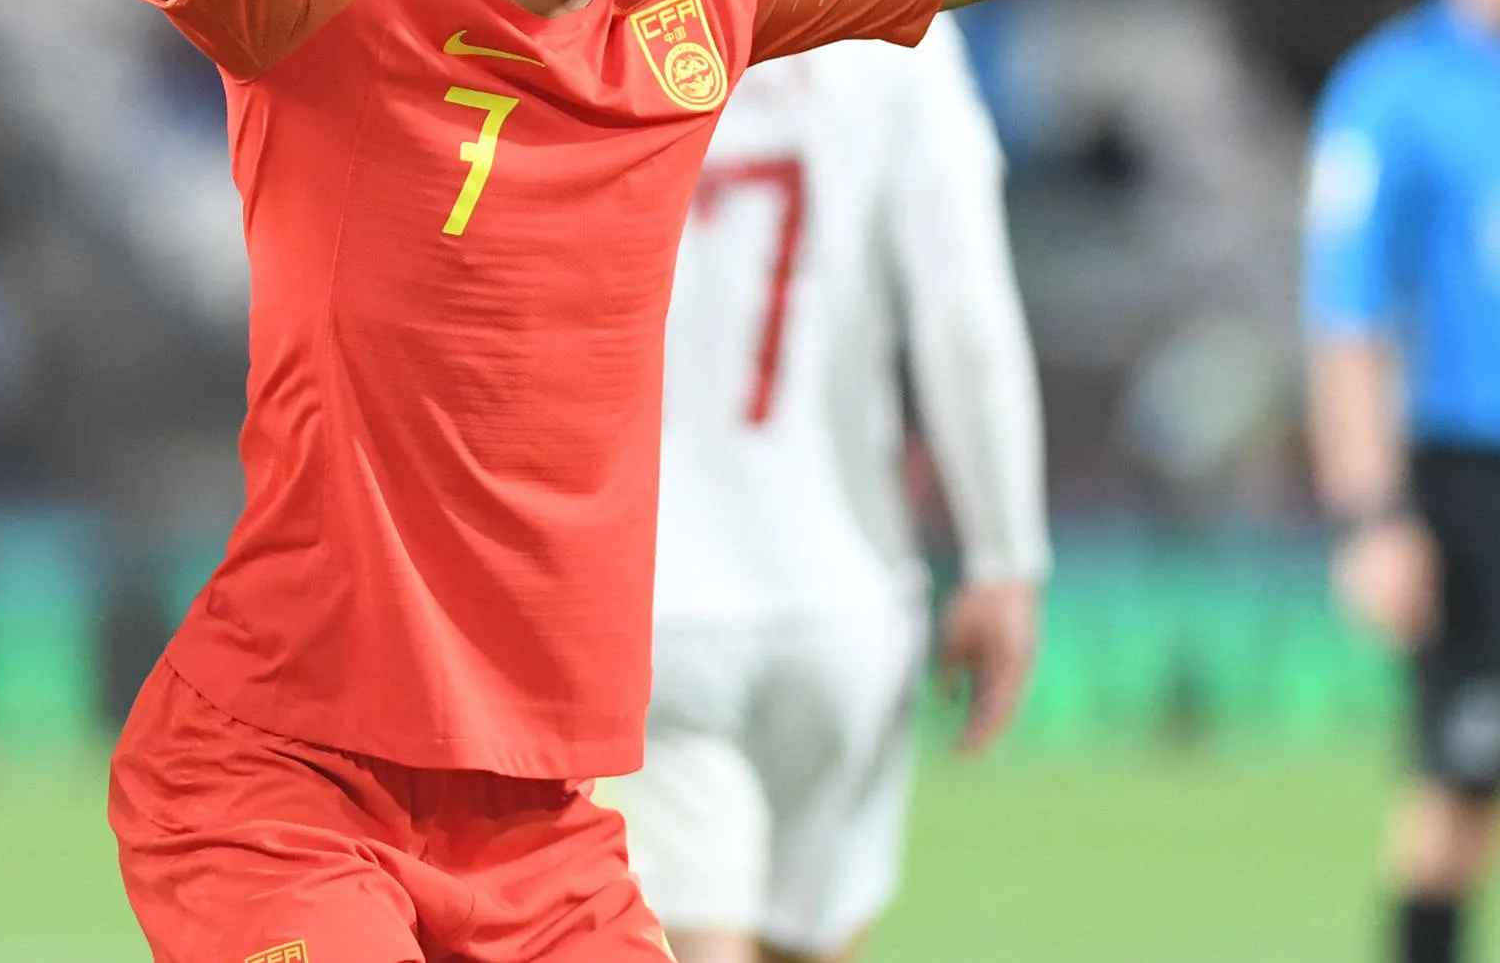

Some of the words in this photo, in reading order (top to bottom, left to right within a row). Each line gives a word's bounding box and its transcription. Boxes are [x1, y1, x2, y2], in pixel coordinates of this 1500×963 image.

[442, 85, 520, 236] 7
[692, 155, 806, 428] 7
[250, 945, 302, 963] FA
